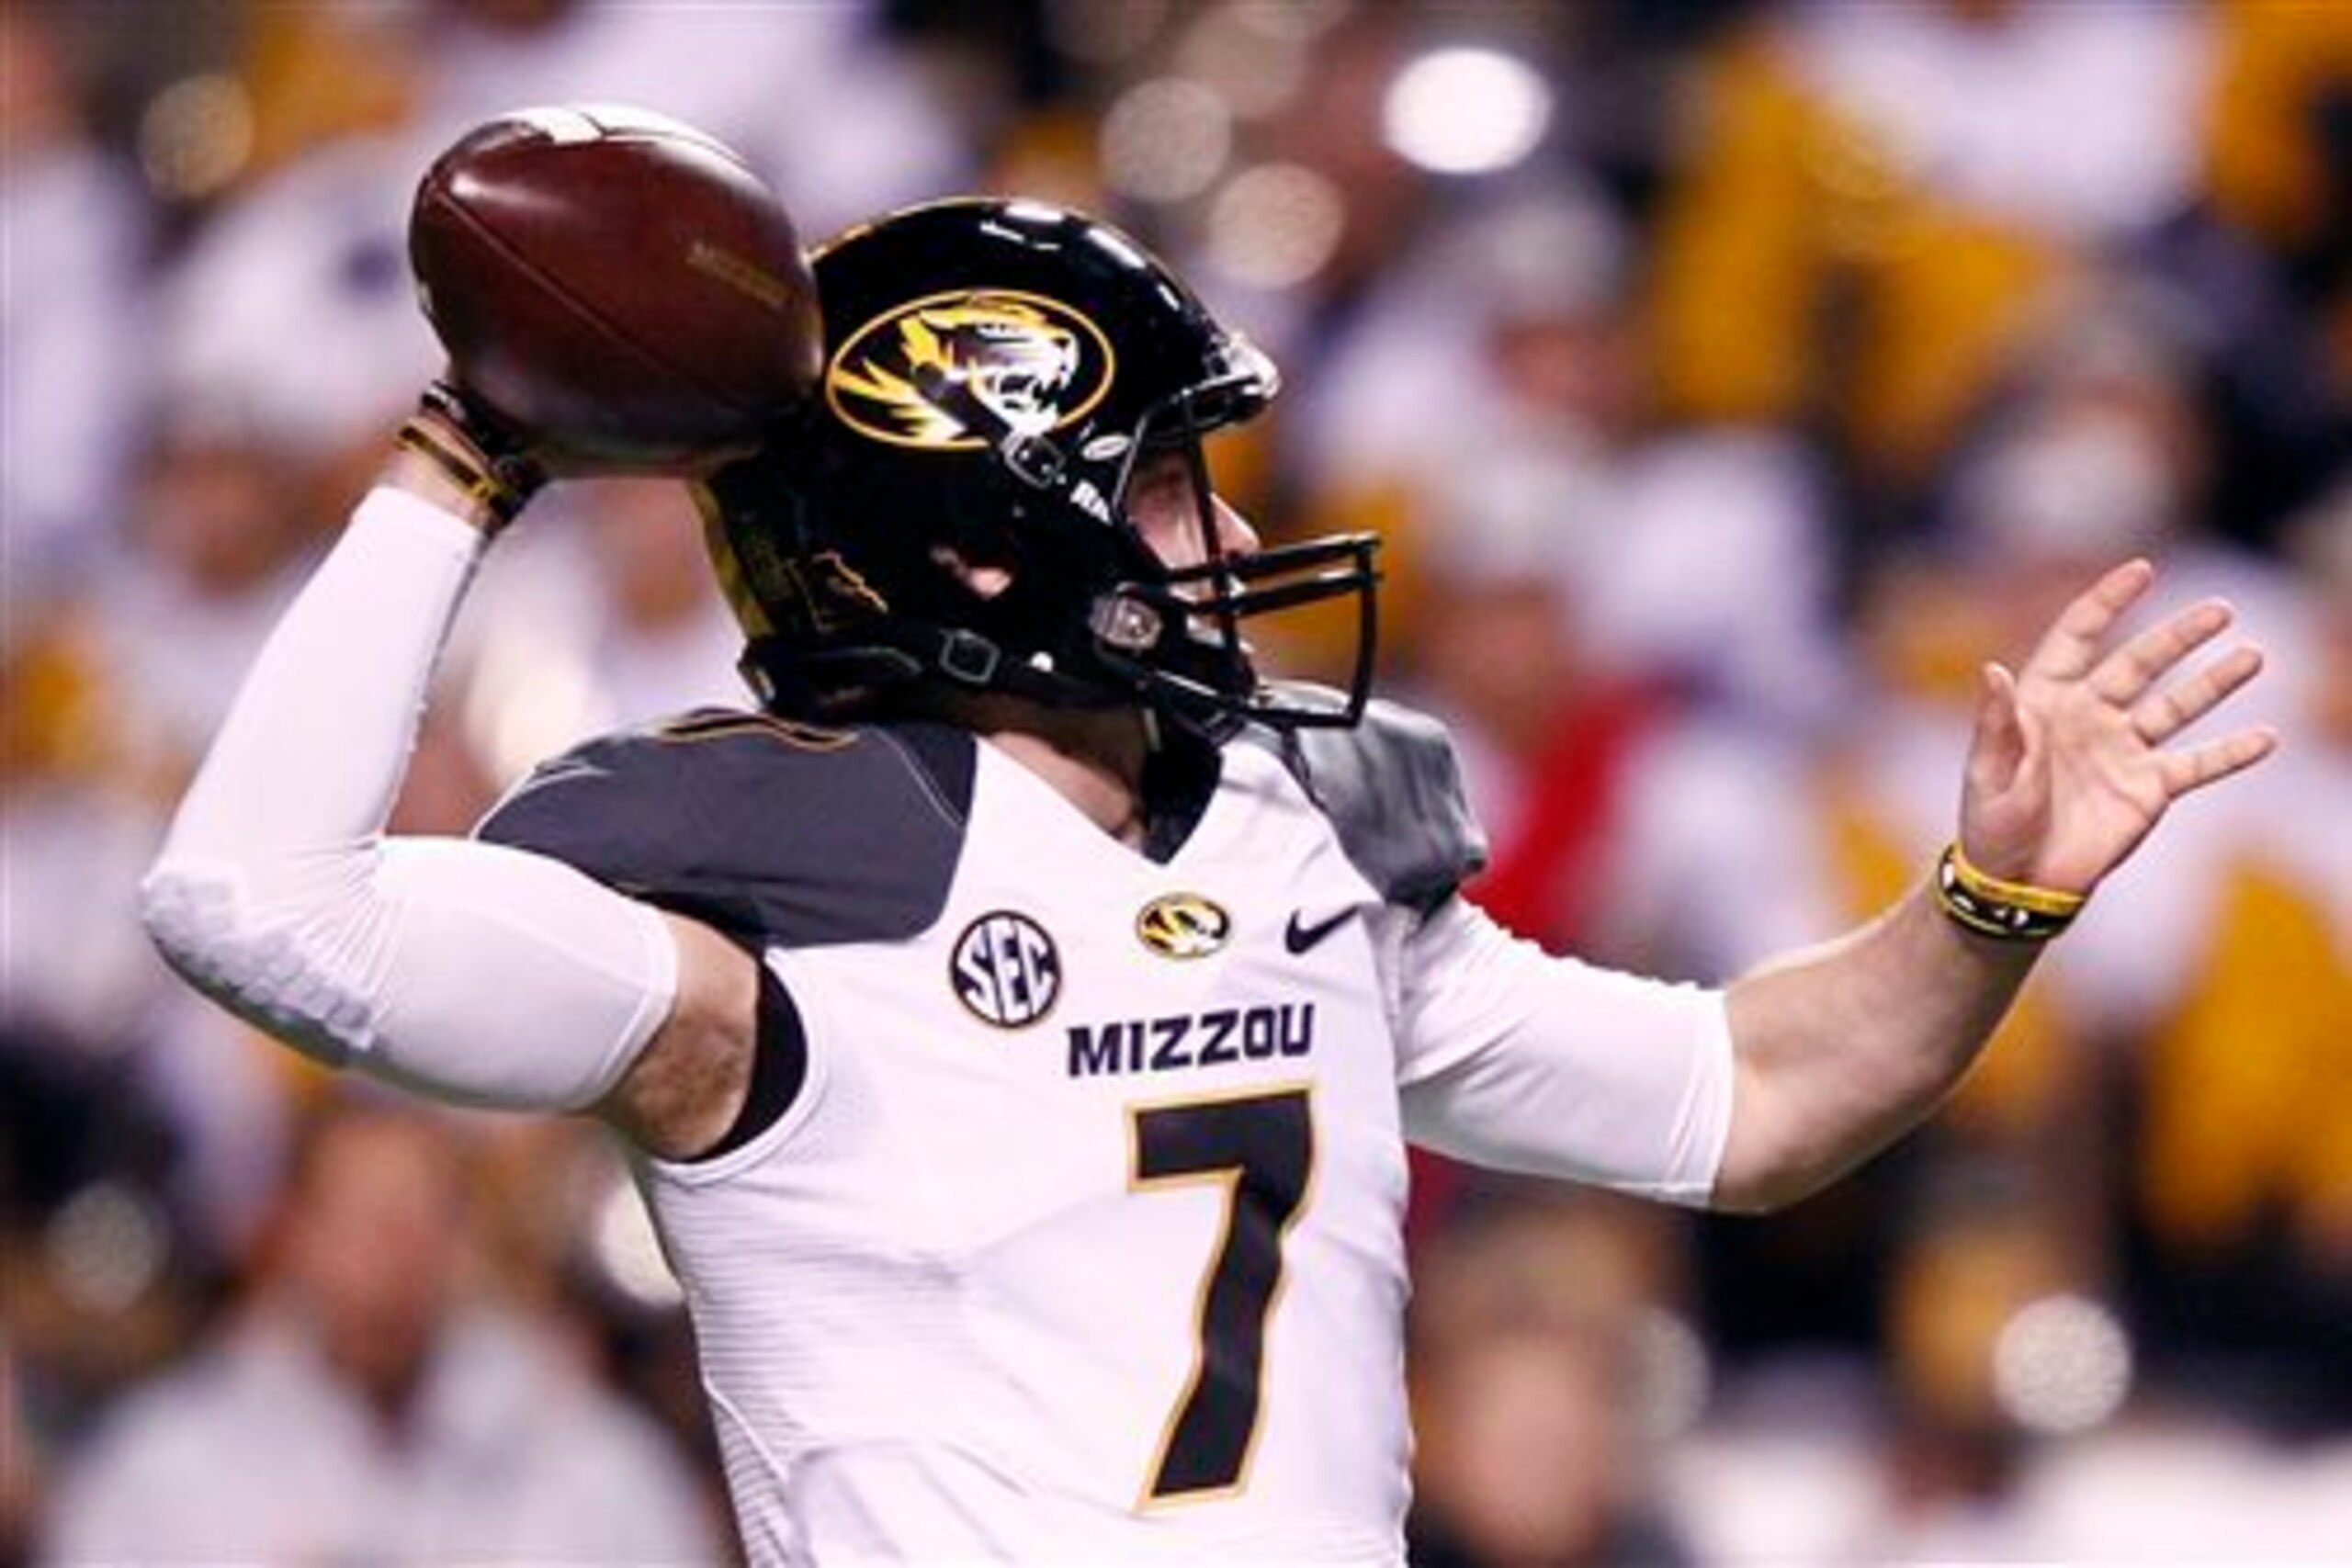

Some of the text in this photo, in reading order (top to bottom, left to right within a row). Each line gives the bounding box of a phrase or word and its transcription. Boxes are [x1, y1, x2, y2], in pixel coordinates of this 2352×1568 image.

[956, 919, 1056, 1023] SEC
[1066, 1003, 1315, 1078] MIZZOU
[1126, 1082, 1317, 1512] 7
